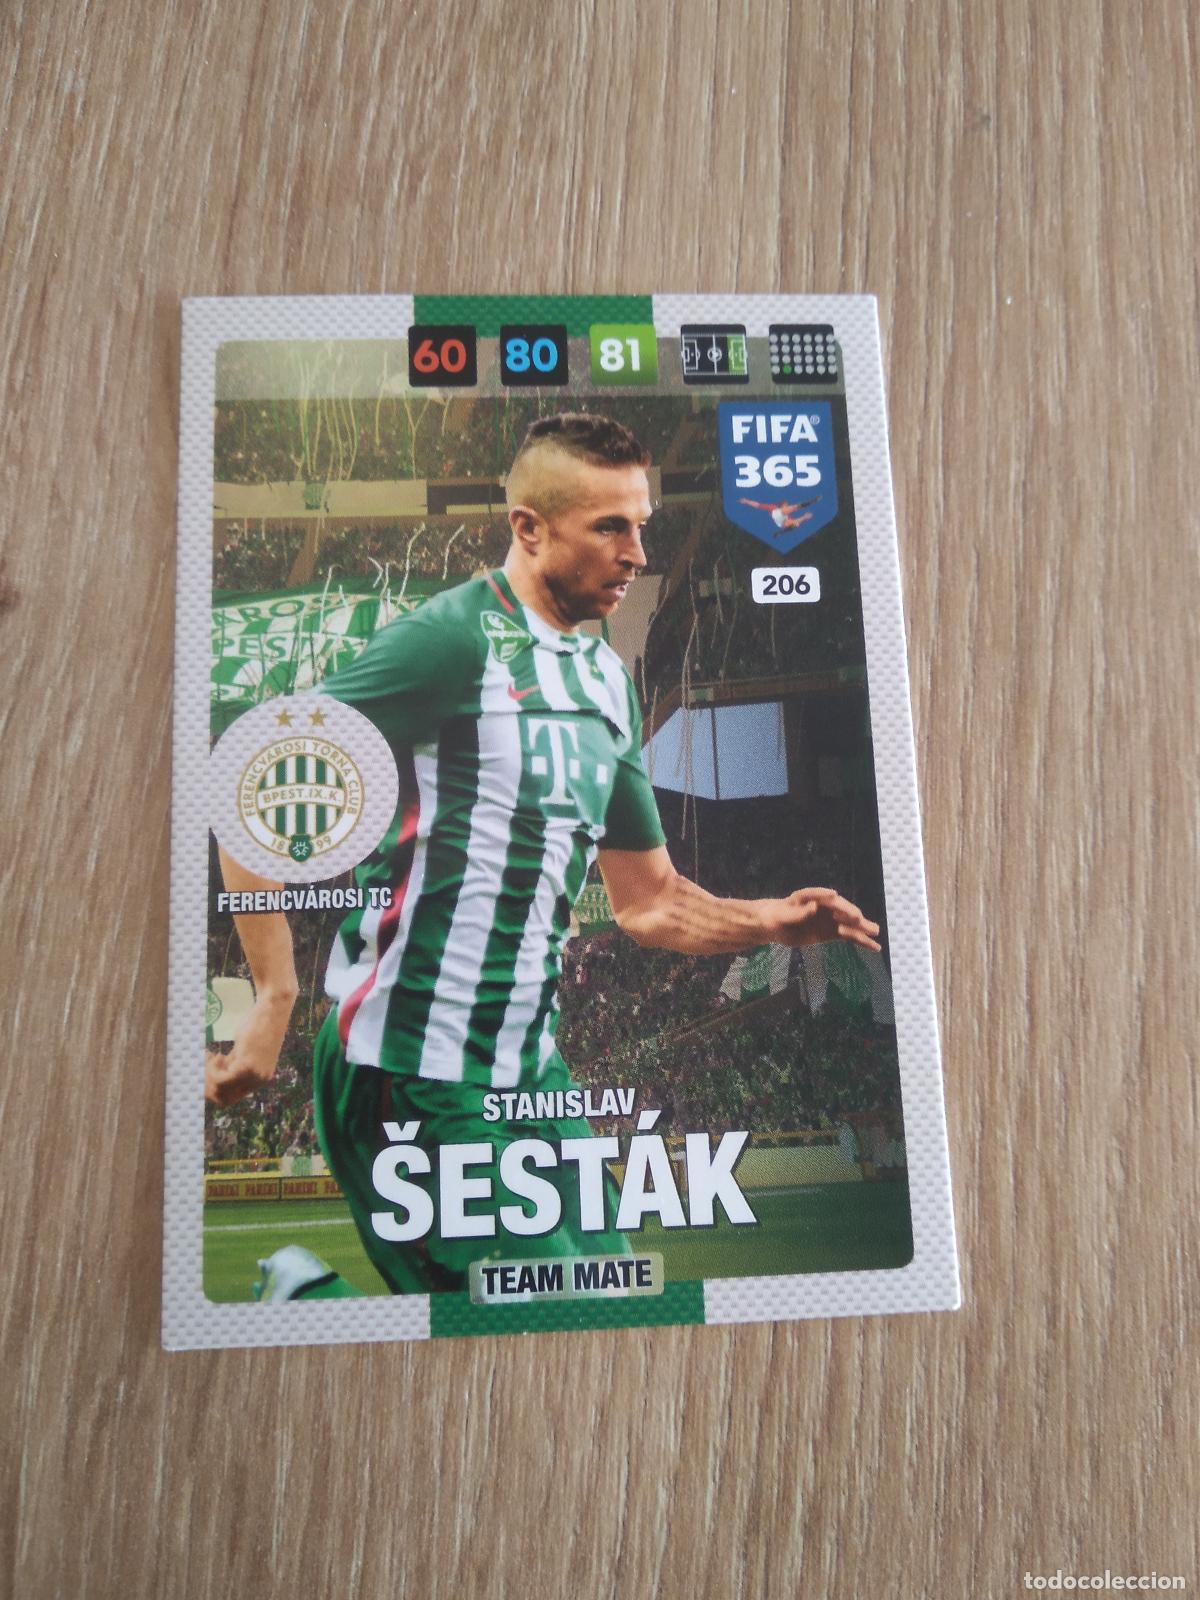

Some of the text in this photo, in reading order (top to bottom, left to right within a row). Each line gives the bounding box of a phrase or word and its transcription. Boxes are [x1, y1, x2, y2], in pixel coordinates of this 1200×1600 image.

[413, 338, 467, 373] 60
[505, 338, 558, 372] 80
[599, 338, 641, 371] 81
[734, 454, 822, 488] 365
[762, 574, 811, 596] 206
[312, 741, 352, 778] TORNA
[347, 780, 359, 815] CLUB
[217, 885, 392, 913] FERENCVÁROSI TC
[482, 1087, 636, 1122] STANISLAV
[371, 1109, 758, 1242] ŠESTÁK
[481, 1259, 653, 1295] TEAM MATE
